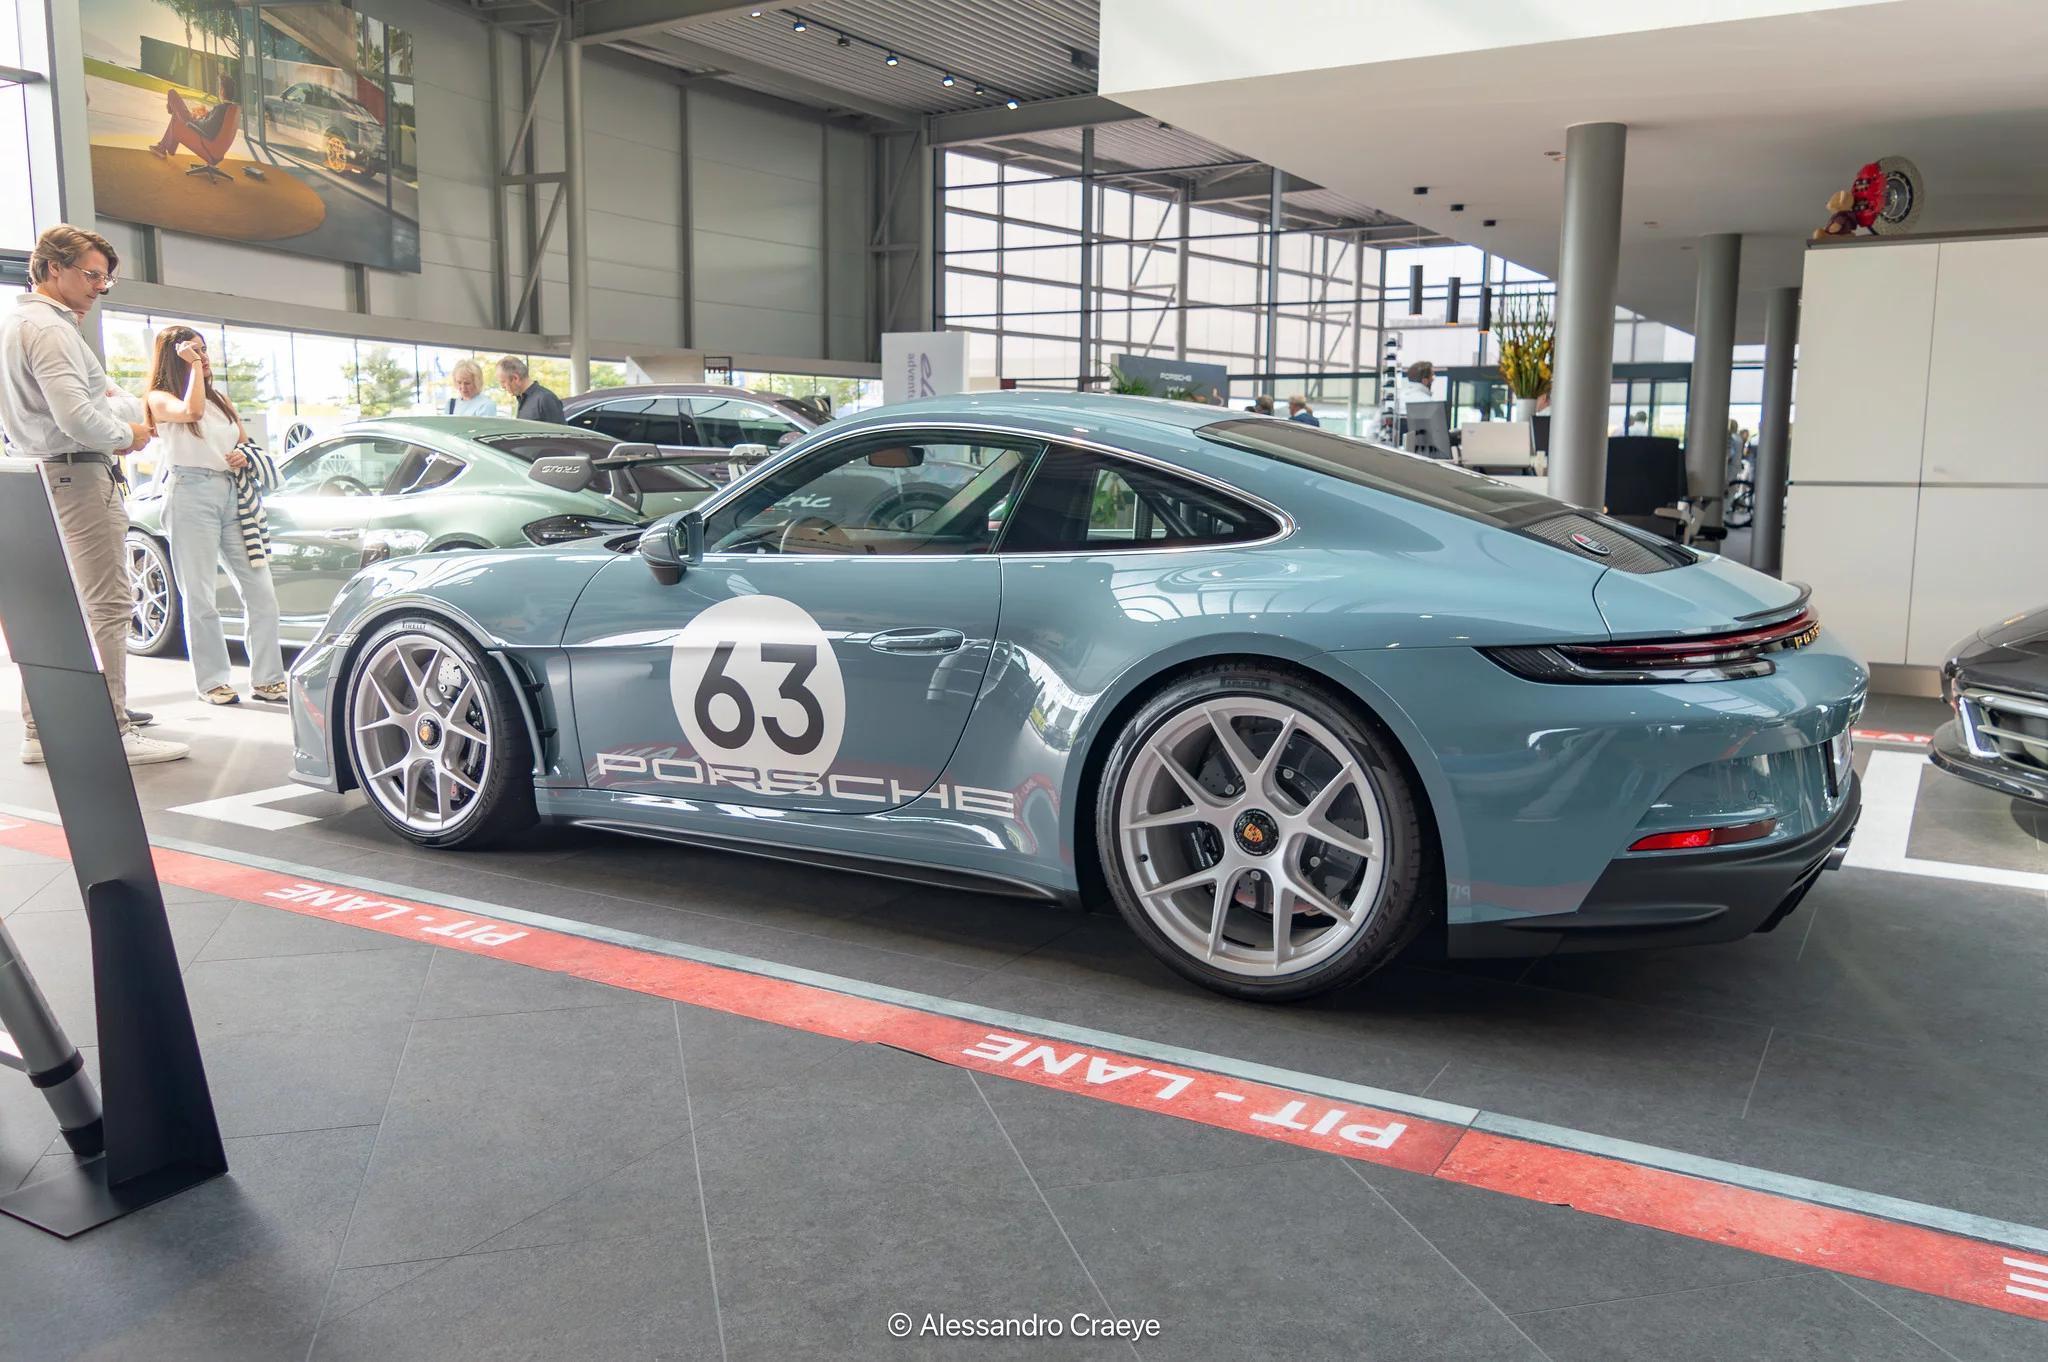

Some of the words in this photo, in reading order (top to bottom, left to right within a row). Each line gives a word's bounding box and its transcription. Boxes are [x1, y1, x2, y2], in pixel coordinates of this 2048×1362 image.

[694, 640, 825, 756] 63
[596, 753, 1014, 819] PORSCHE
[264, 883, 414, 920] LANE
[421, 919, 529, 946] PIT
[962, 1033, 1195, 1100] LANE
[1249, 1100, 1407, 1149] PIT
